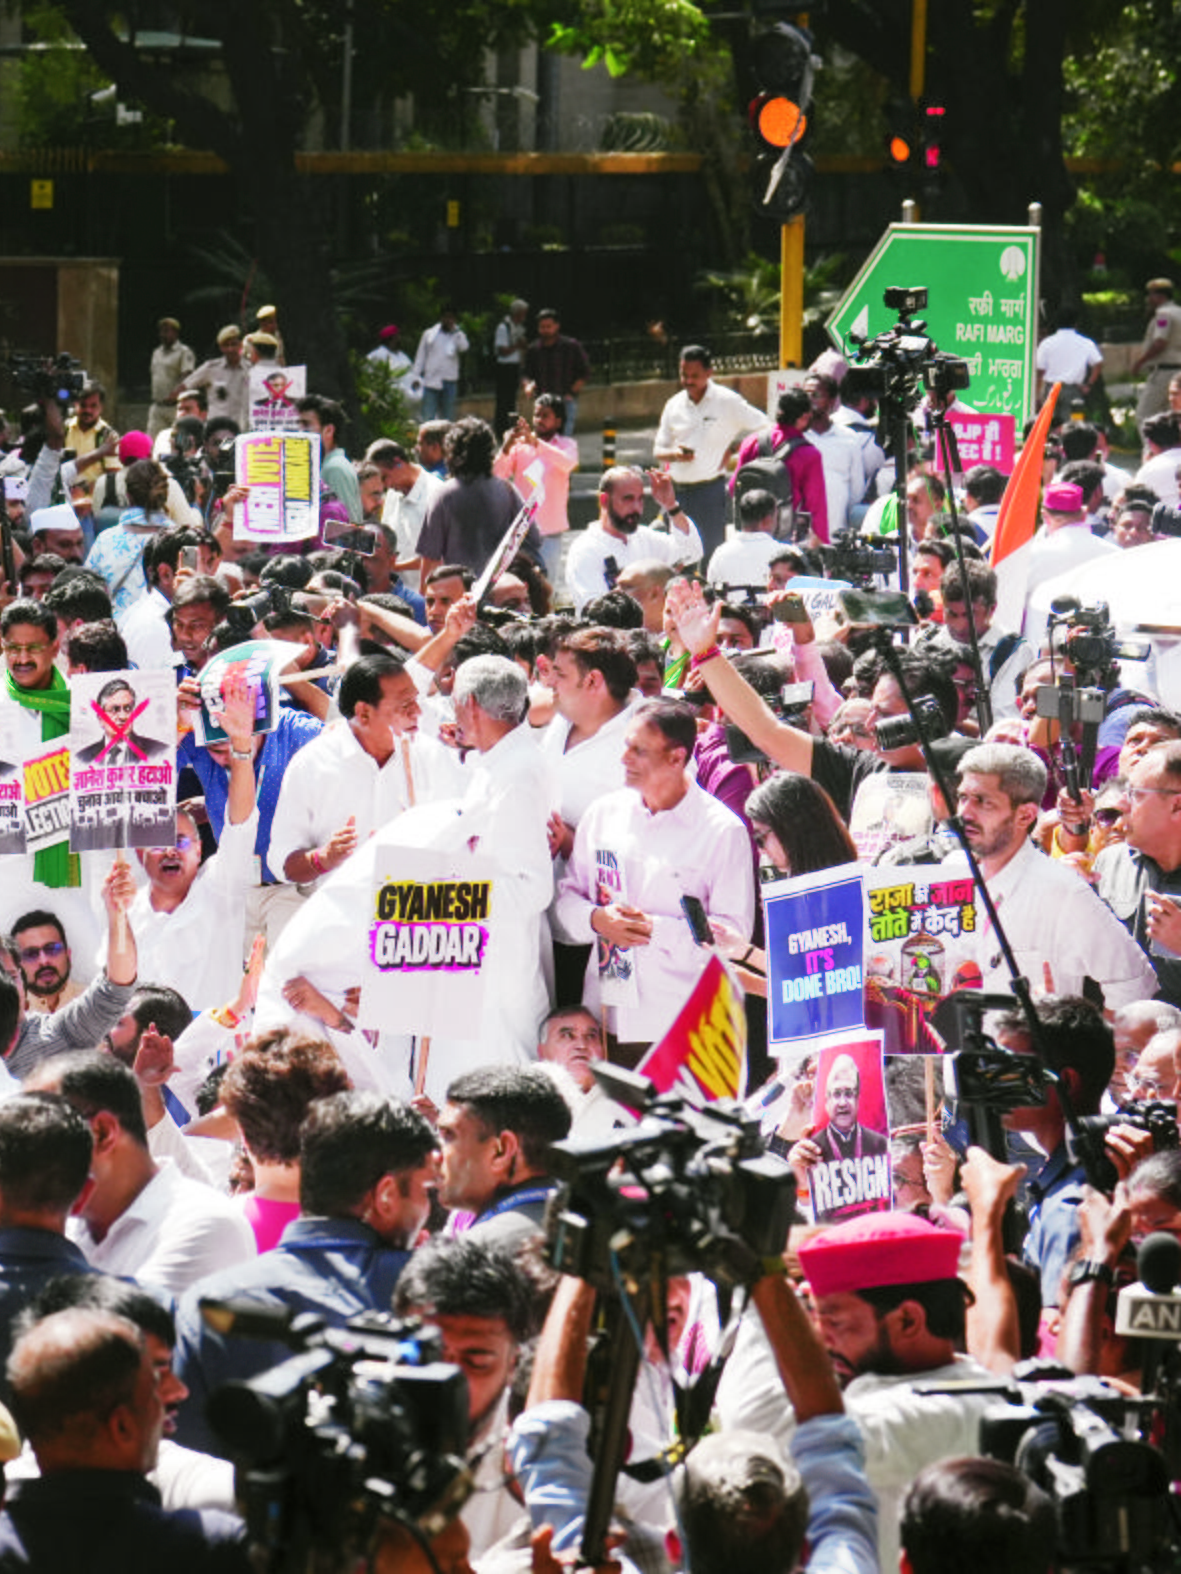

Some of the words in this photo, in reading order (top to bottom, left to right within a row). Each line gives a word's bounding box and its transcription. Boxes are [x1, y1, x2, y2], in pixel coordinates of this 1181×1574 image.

[1000, 293, 1025, 319] मार्ग
[956, 323, 984, 342] RAFI
[987, 325, 1024, 344] MARG
[953, 423, 982, 440] BJP
[137, 759, 173, 785] हटाओ
[376, 882, 490, 921] GYANESH
[869, 882, 915, 914] राजा
[929, 877, 976, 905] जान
[787, 921, 852, 955] GYANESH,
[869, 907, 910, 942] तोते
[961, 903, 977, 932] है
[375, 922, 483, 970] GADDAR
[805, 947, 835, 975] IT'S
[781, 973, 824, 1005] DONE
[825, 964, 863, 996] BRO!
[812, 1153, 890, 1213] RESIGN
